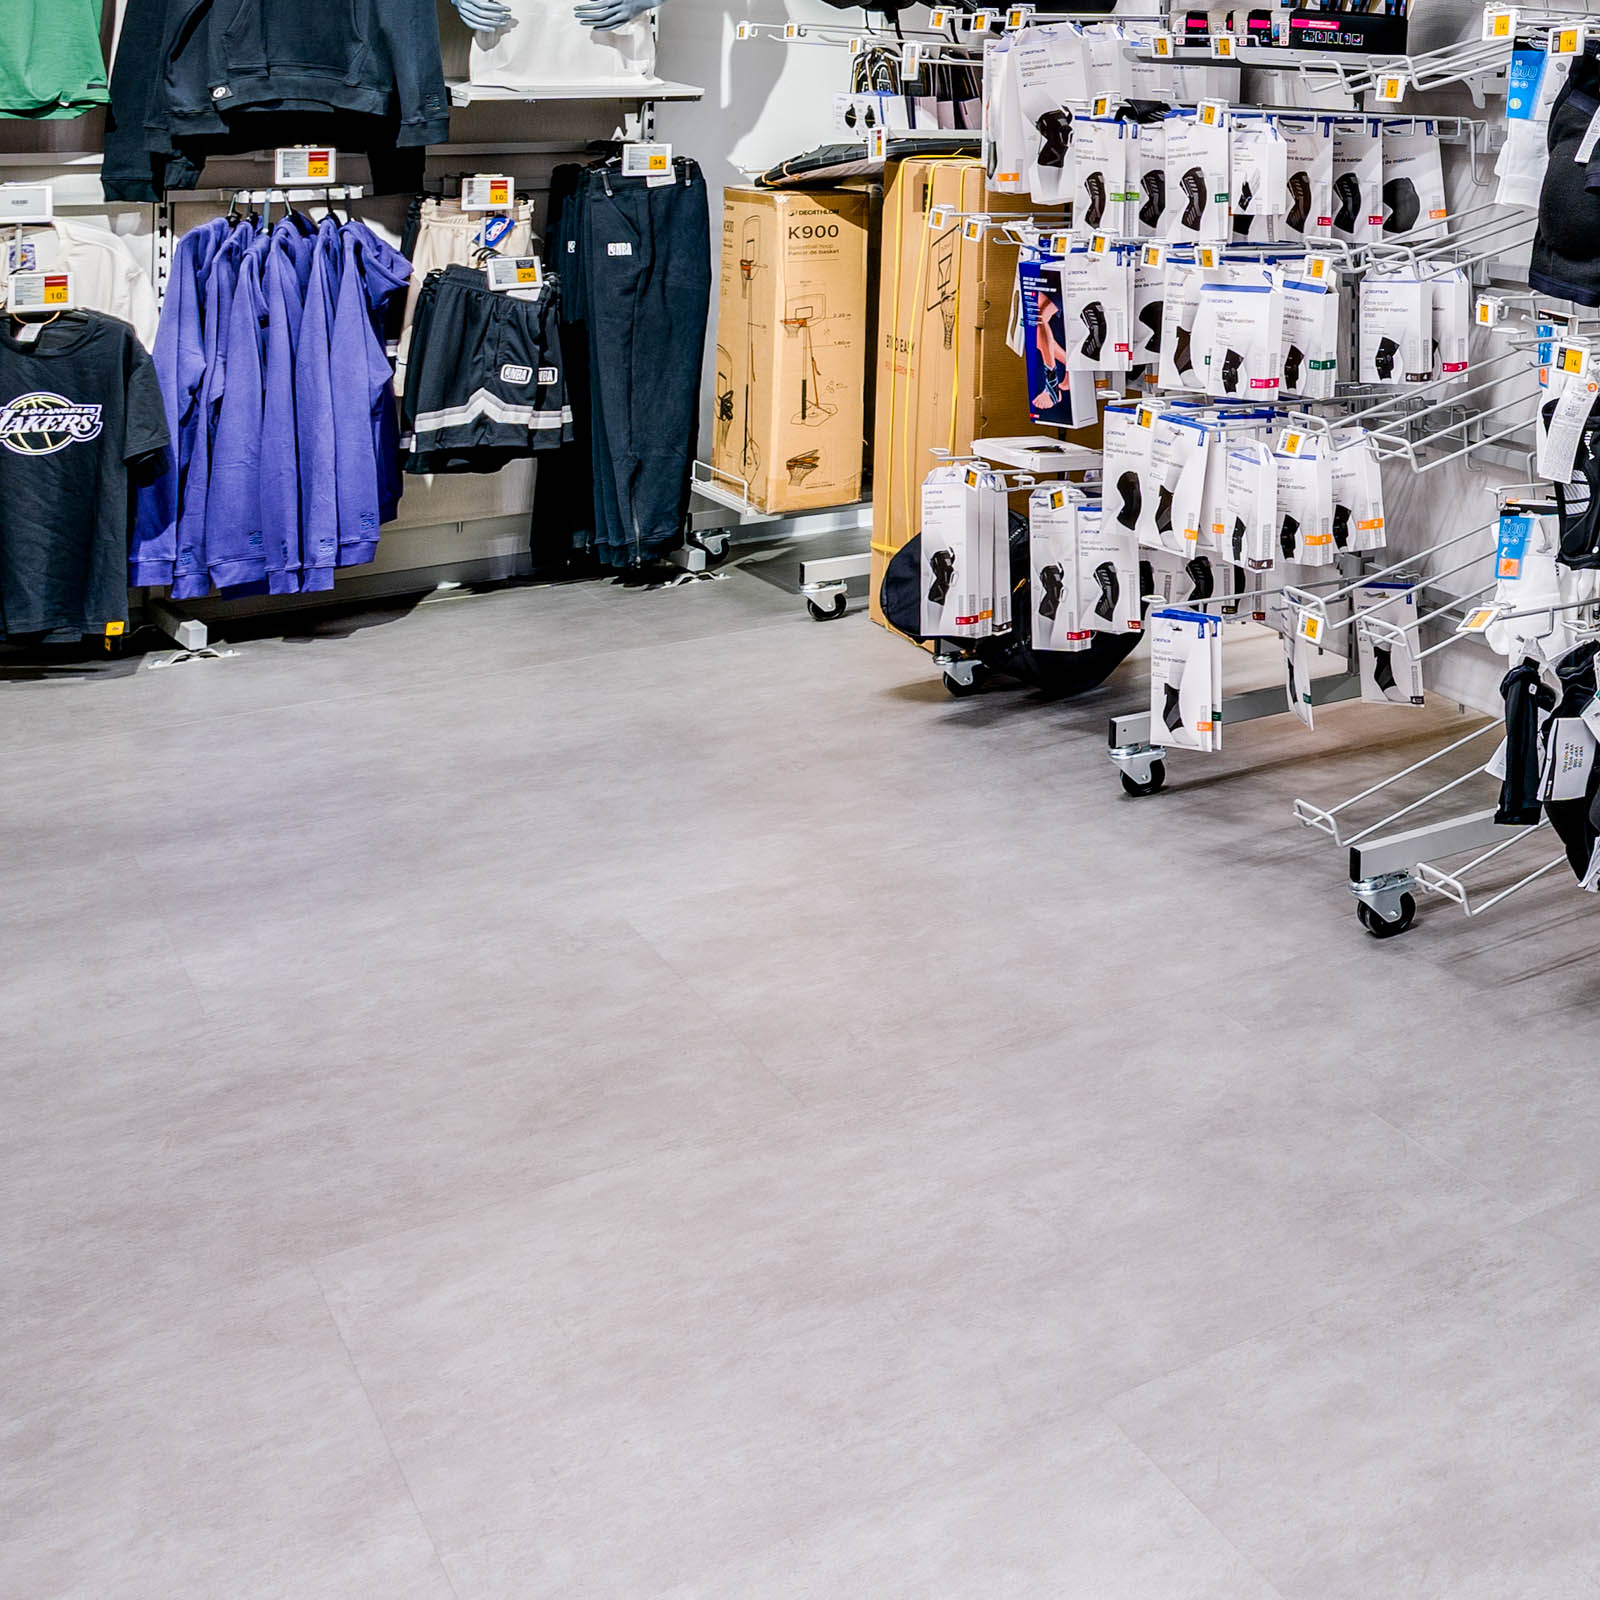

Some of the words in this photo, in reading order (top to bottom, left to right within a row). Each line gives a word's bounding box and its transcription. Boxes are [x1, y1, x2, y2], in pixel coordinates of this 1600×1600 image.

[788, 224, 839, 240] K900
[44, 406, 98, 415] ANGELES
[0, 406, 95, 437] LAKERS
